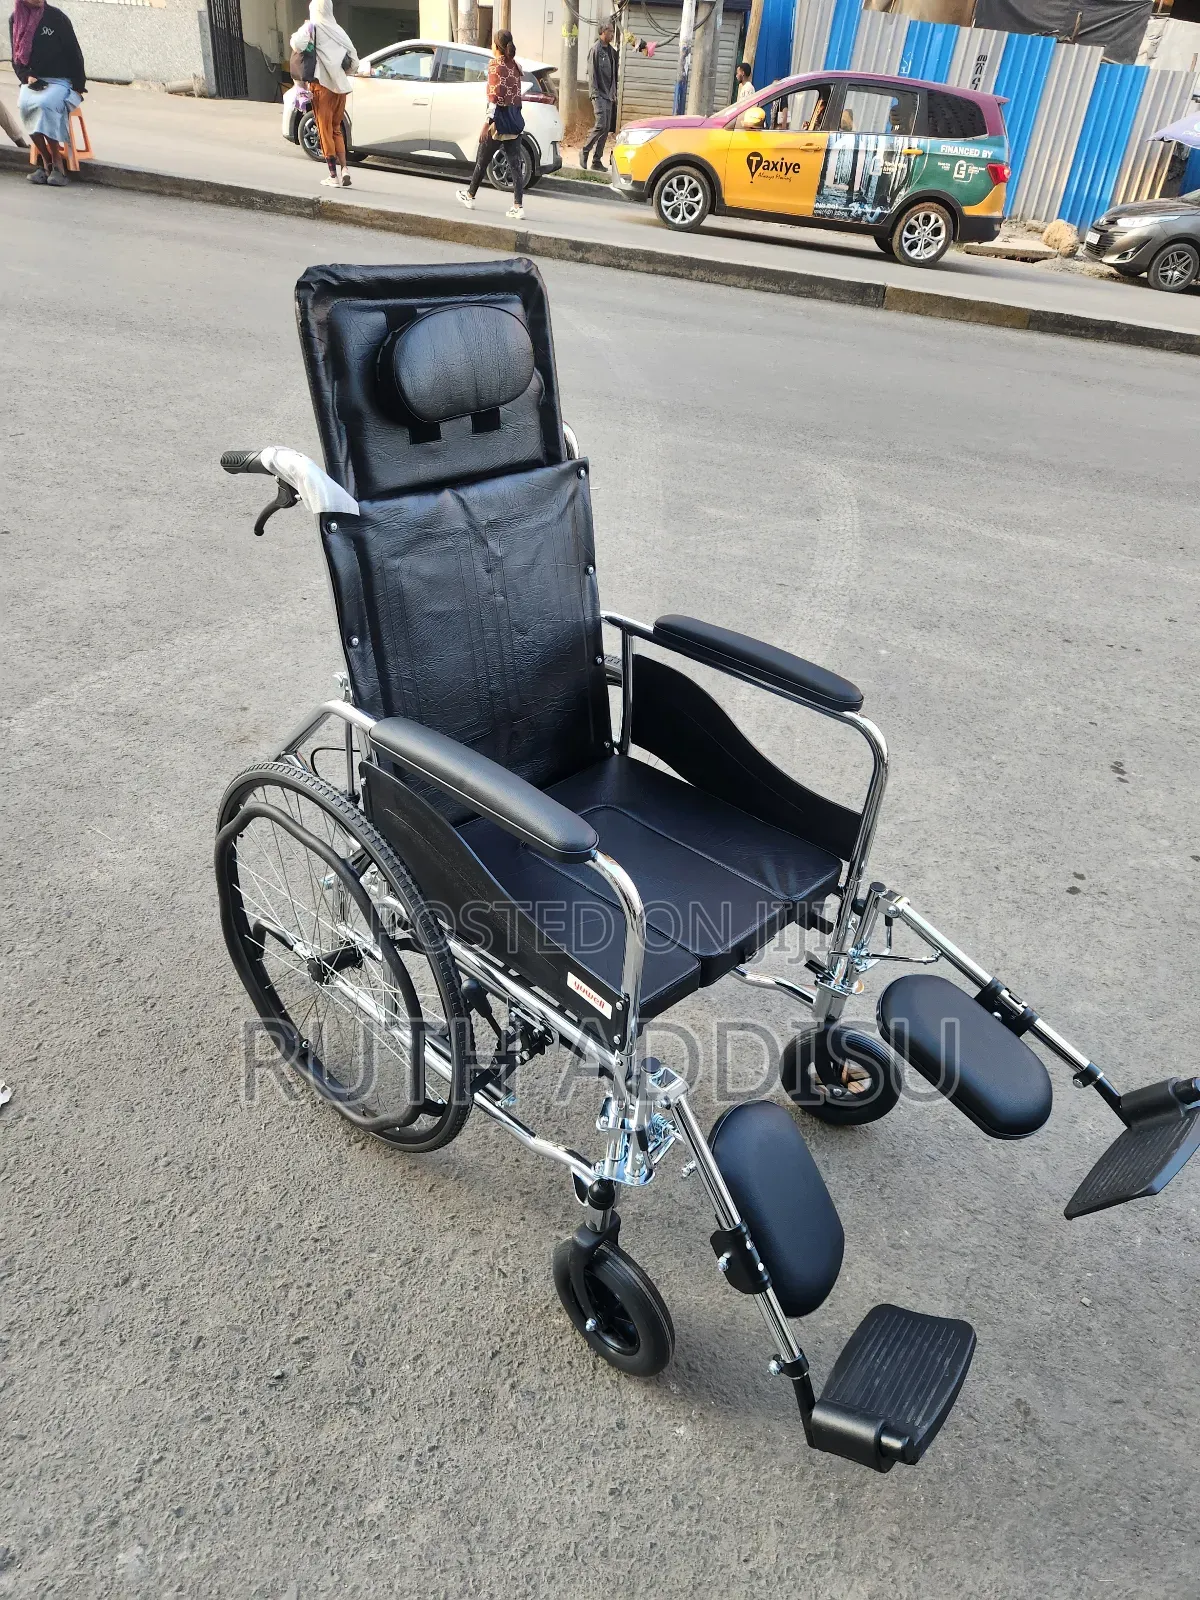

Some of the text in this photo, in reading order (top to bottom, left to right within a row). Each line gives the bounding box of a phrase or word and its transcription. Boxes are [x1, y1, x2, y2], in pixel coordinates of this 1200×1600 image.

[940, 144, 994, 159] FINANCED BY
[747, 153, 801, 176] Taxiye
[573, 980, 606, 1010] yuwell
